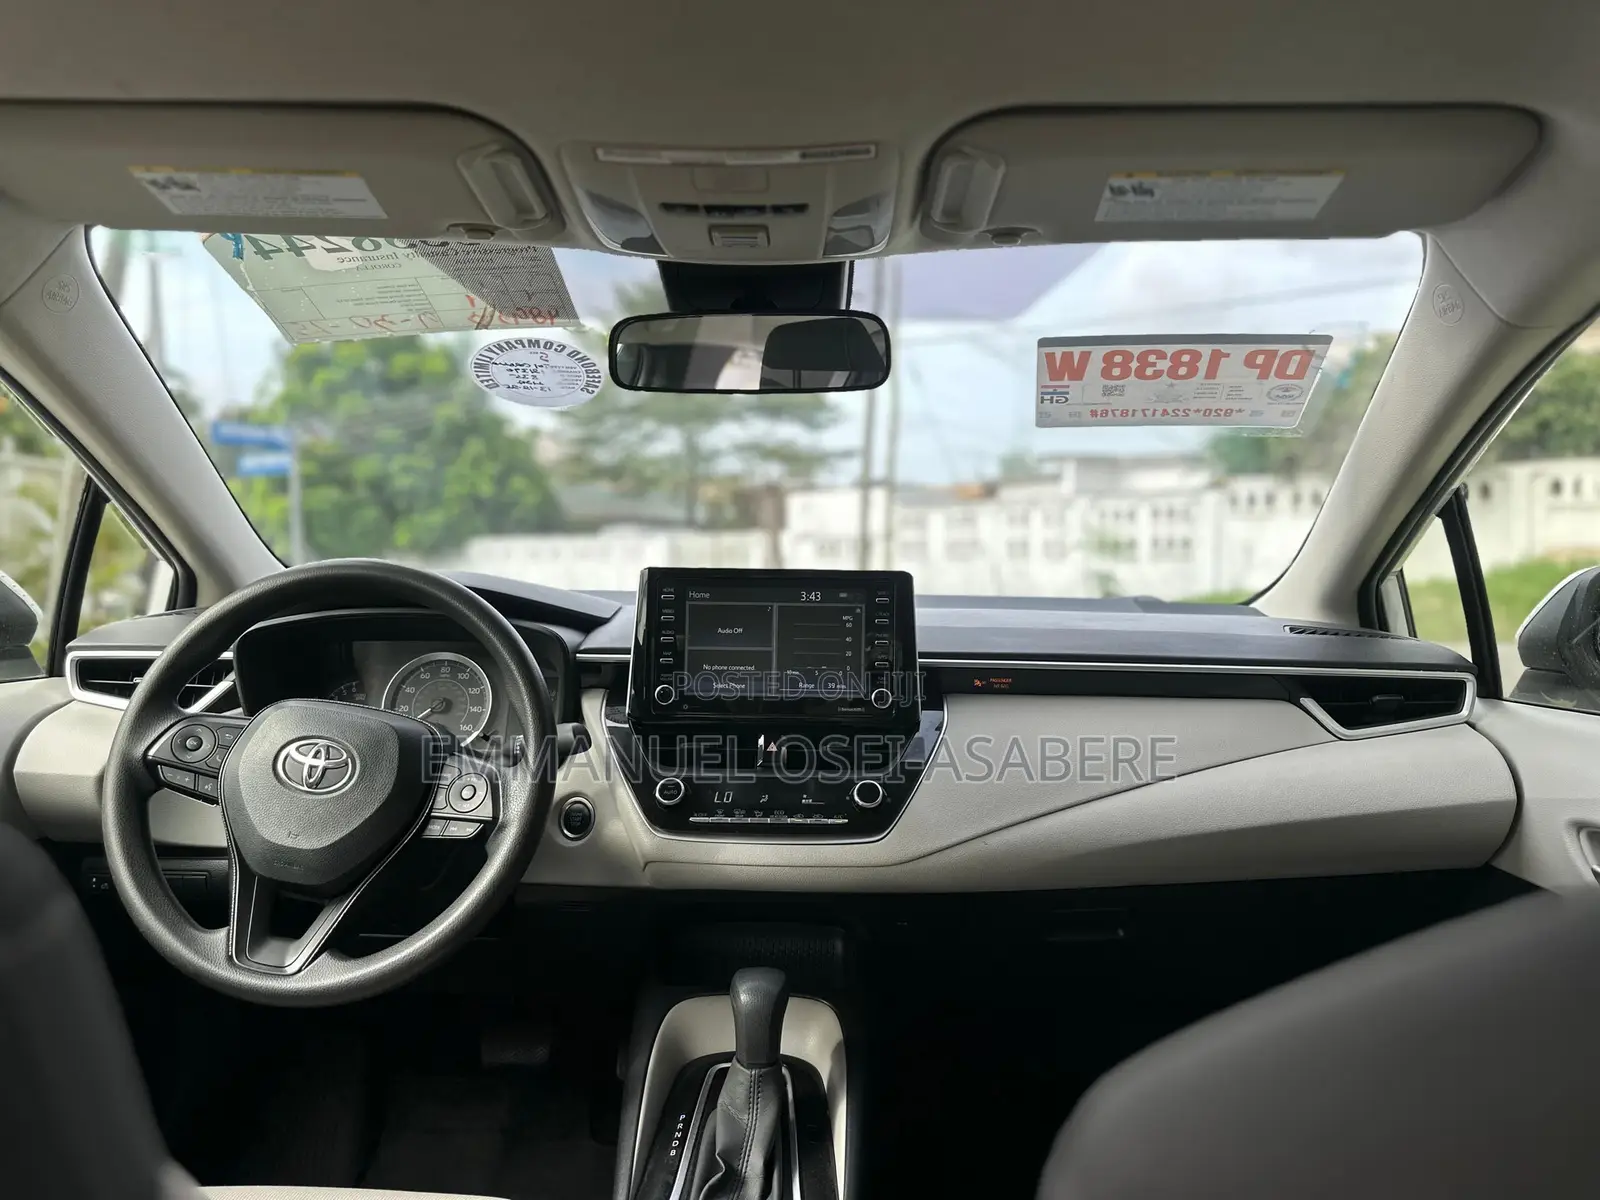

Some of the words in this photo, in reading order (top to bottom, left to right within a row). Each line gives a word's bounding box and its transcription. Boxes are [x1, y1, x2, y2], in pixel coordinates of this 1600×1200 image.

[689, 591, 710, 599] Home
[800, 591, 821, 601] 3:43
[714, 791, 733, 803] LO
